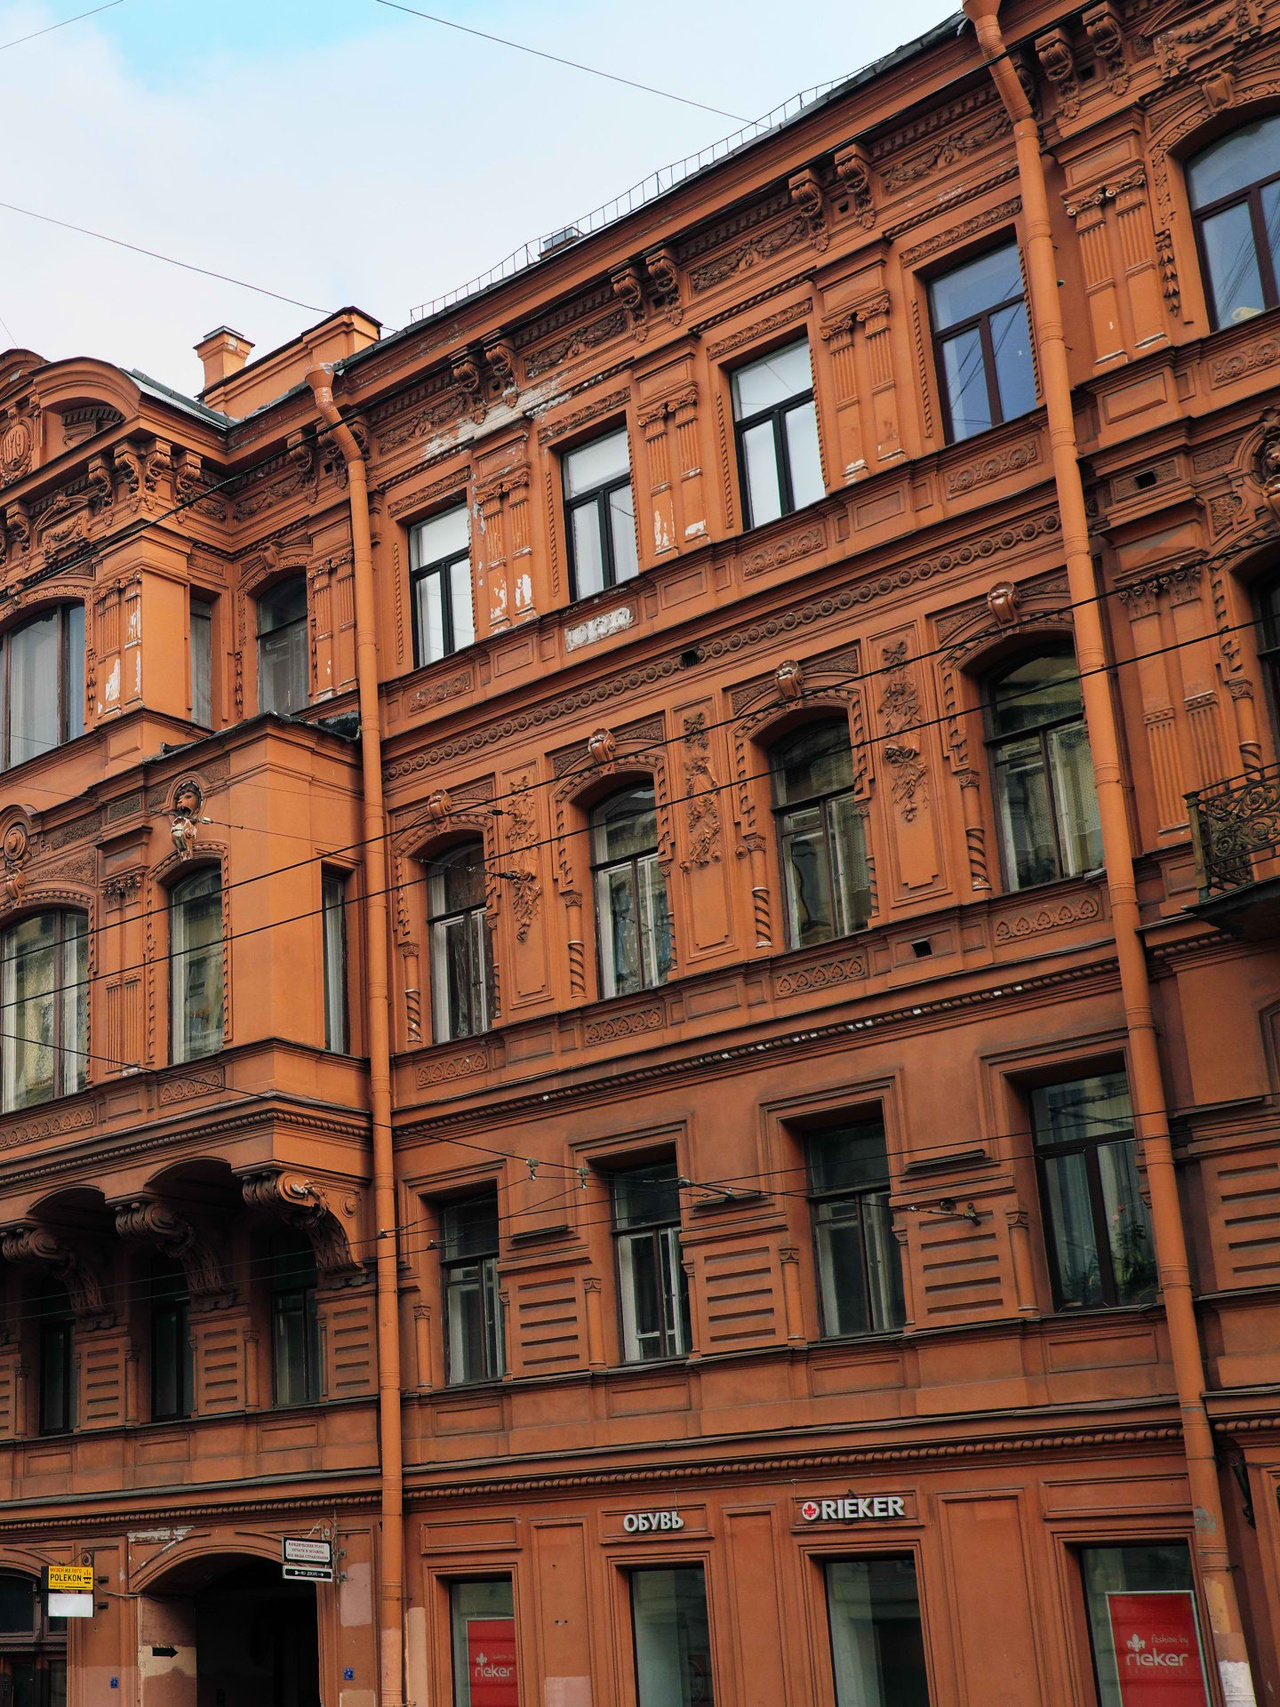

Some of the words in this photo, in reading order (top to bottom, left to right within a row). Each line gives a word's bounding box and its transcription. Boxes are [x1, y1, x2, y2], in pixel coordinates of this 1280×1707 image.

[821, 1496, 906, 1520] RIEKER
[623, 1511, 684, 1532] ОБУВЬ
[50, 1573, 82, 1581] POLEKON
[1126, 1648, 1188, 1667] rieker
[474, 1664, 513, 1677] rieker
